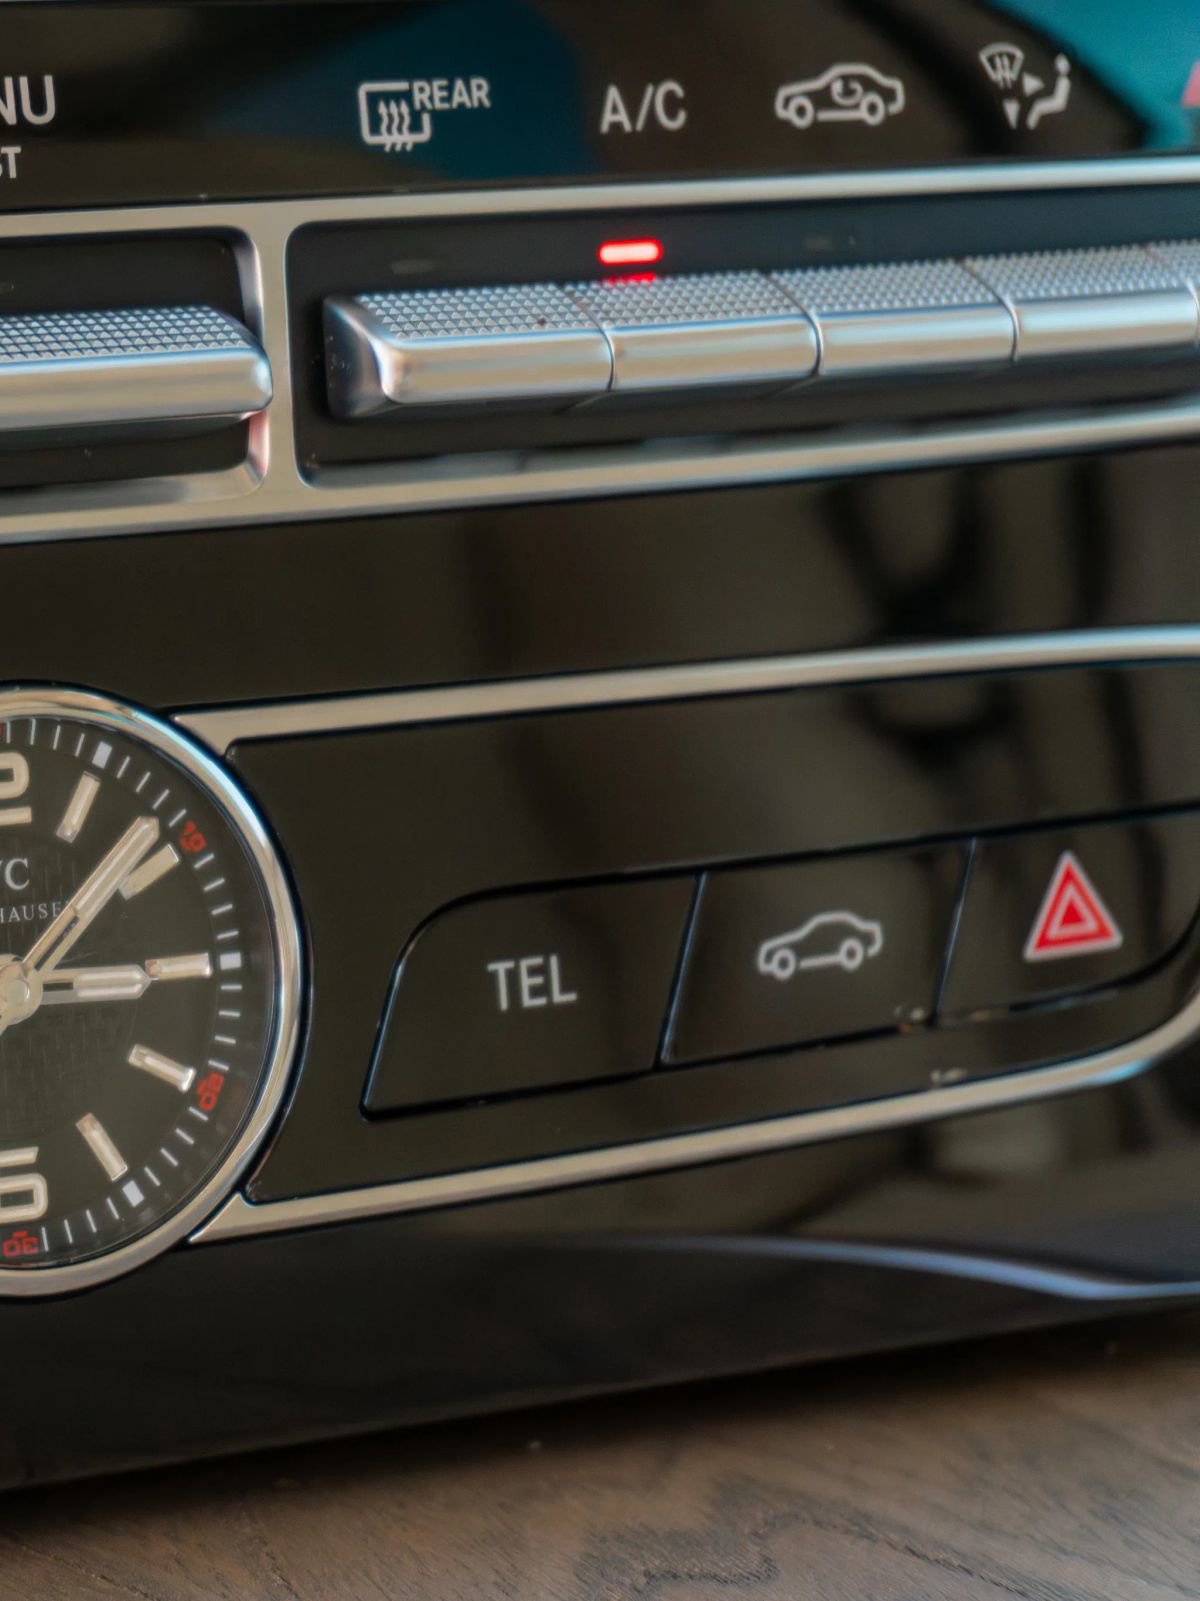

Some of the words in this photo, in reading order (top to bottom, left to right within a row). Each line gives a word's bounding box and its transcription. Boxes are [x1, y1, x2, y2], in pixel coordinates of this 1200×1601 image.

[412, 77, 492, 111] REAR
[600, 80, 687, 134] A/C
[487, 954, 579, 1012] TEL
